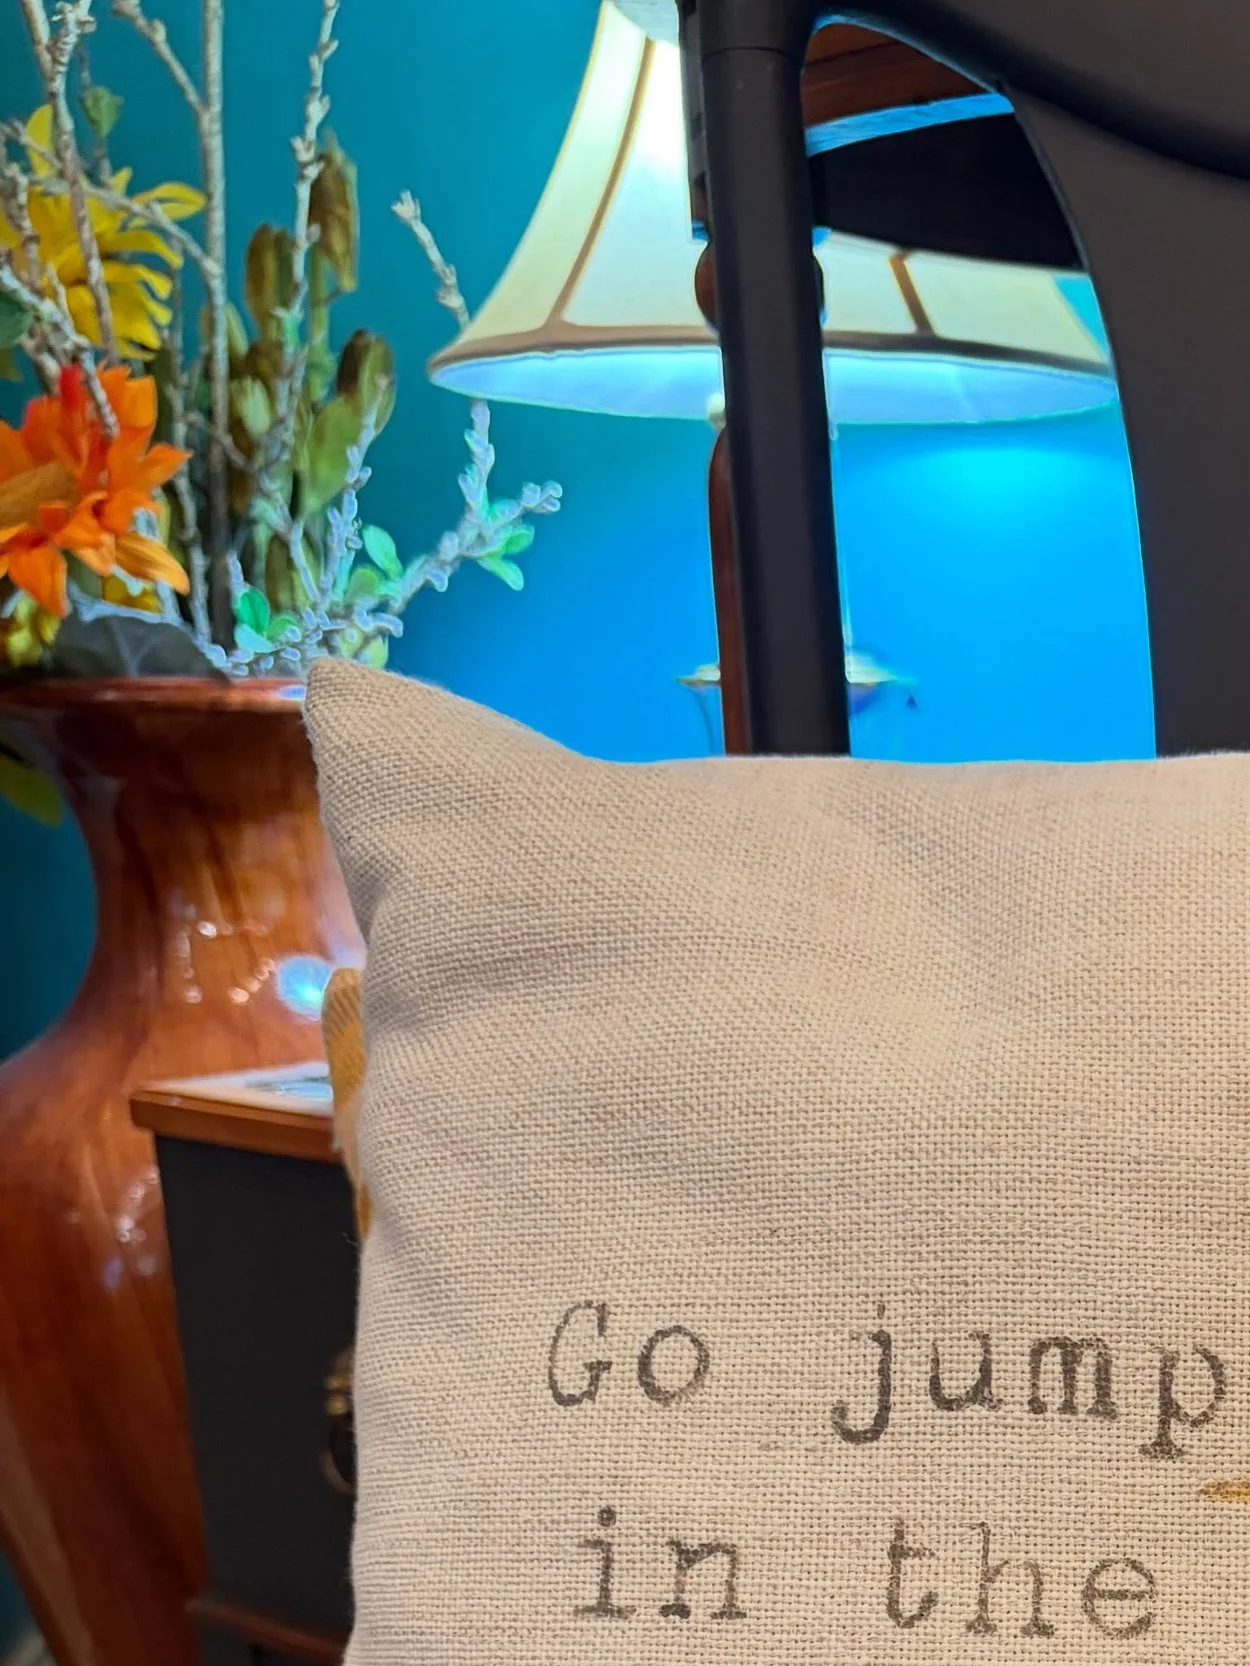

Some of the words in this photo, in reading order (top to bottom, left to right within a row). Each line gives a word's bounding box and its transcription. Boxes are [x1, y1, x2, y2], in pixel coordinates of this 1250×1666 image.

[548, 1300, 710, 1407] Go
[831, 1302, 1227, 1460] jump
[573, 1506, 747, 1620] in
[886, 1518, 1158, 1640] the
